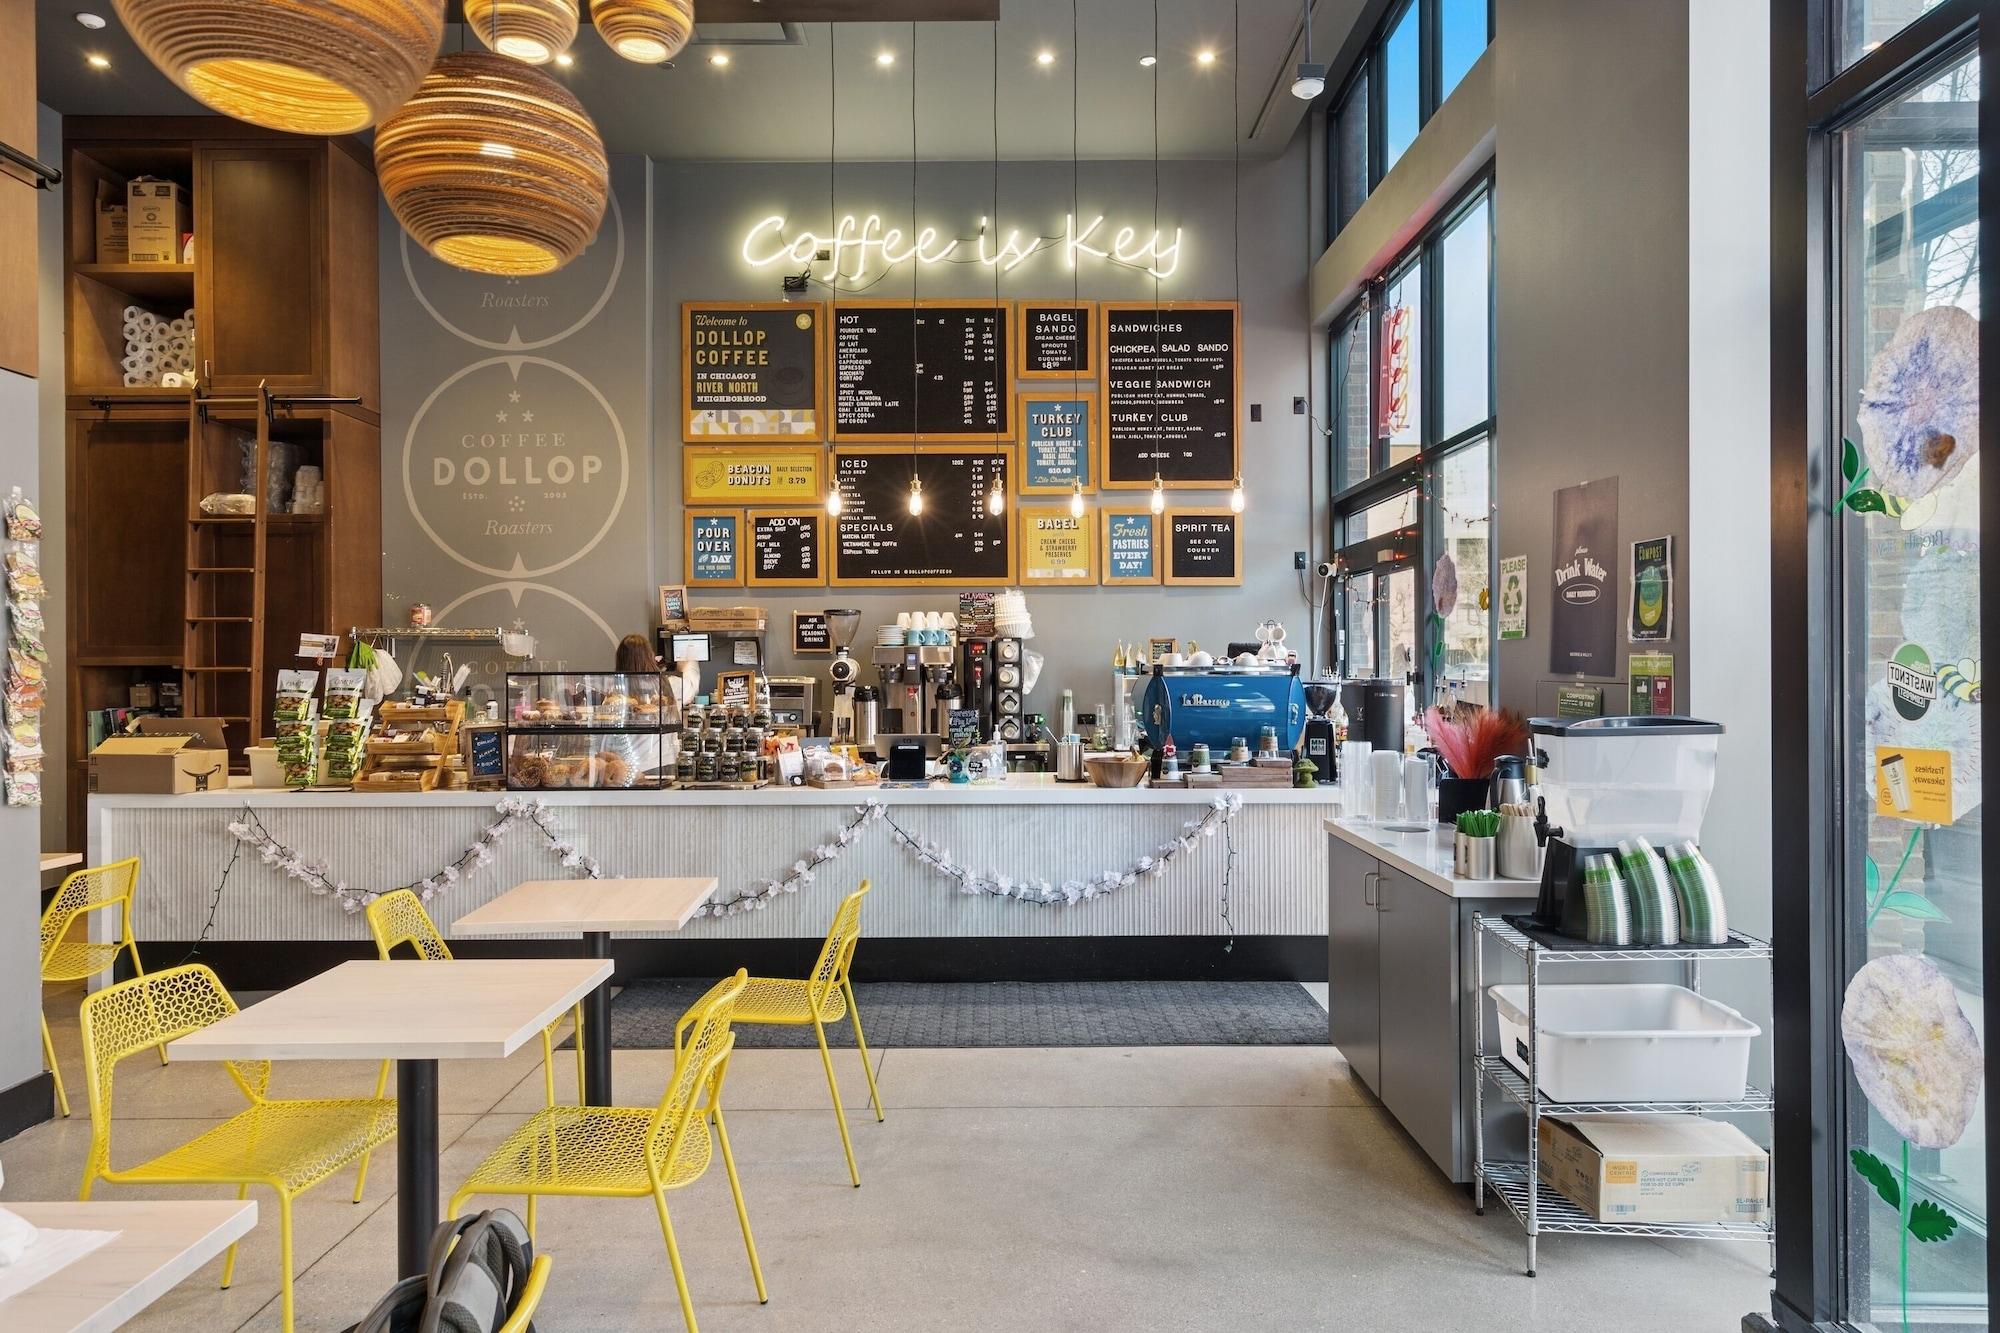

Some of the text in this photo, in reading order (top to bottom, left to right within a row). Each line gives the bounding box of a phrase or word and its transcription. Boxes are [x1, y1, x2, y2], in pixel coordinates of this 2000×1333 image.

[741, 213, 1182, 282] Coffee is Key
[480, 292, 551, 309] Roasters
[695, 315, 748, 326] Welcome to
[840, 316, 859, 324] HOT
[1035, 325, 1076, 333] SANDO
[1110, 324, 1183, 332] SANDWICHES
[696, 330, 766, 346] DOLLOP
[1110, 344, 1229, 353] CHICKPEA SALAD SANDO
[696, 350, 769, 365] COFFEE
[696, 382, 758, 393] RIVER NORTH
[1156, 380, 1211, 388] SANDWICH
[1032, 414, 1081, 425] TURKEY
[1112, 413, 1188, 422] TURKEY CLUB
[1041, 427, 1072, 438] CLUB
[462, 432, 566, 449] COFFEE
[728, 464, 771, 475] BEACON
[841, 460, 868, 468] ICED
[433, 455, 603, 486] DOLLOP
[728, 476, 771, 486] DONUTS
[768, 518, 800, 526] ADD ON
[840, 523, 894, 532] SPECIALS
[1037, 518, 1079, 530] BAGEL
[484, 519, 553, 537] Roasters
[697, 528, 730, 538] POUR
[1113, 524, 1148, 537] Fresh
[1175, 524, 1230, 533] SPIRIT TEA
[697, 541, 730, 552] OVER
[1113, 539, 1149, 550] PASTRIES
[711, 555, 732, 563] DAY
[1113, 552, 1149, 560] EVERY
[1638, 546, 1662, 561] COMPOST
[1119, 561, 1143, 569] DAY!
[1502, 559, 1526, 574] PLEASE
[1555, 558, 1607, 587] Drink Water
[1192, 693, 1230, 708] Marzocco
